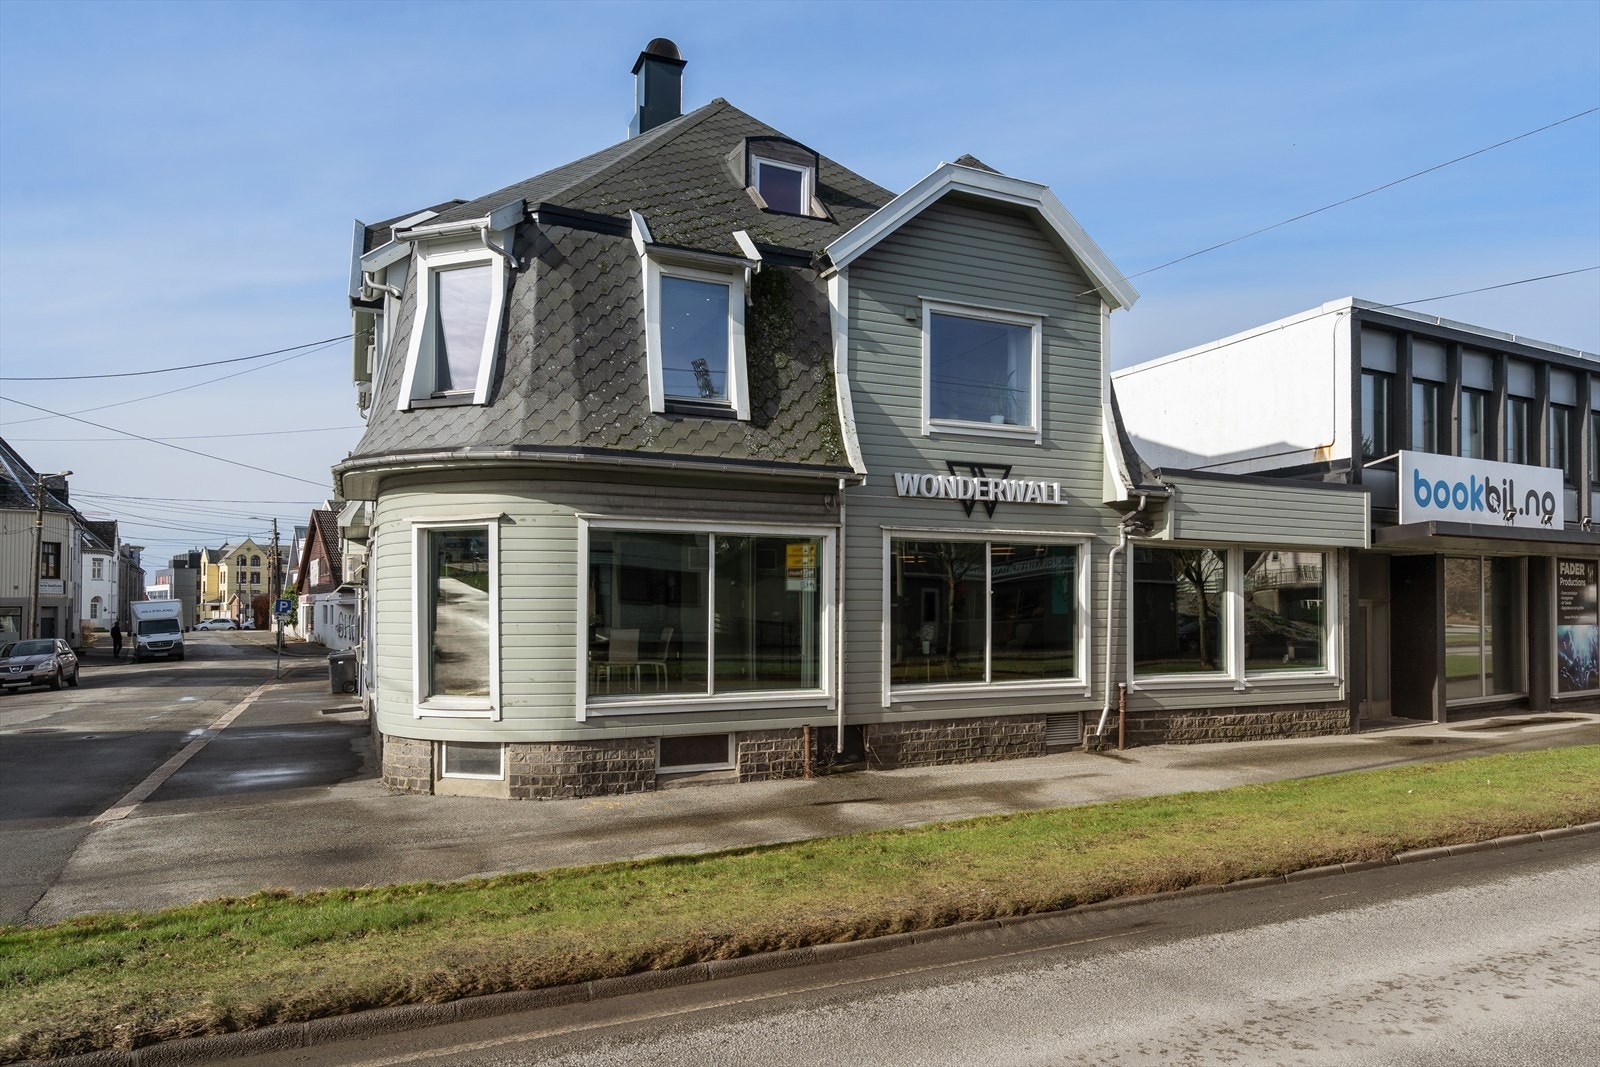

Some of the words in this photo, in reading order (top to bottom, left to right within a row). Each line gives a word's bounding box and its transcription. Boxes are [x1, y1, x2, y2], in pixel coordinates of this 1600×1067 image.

[894, 472, 1068, 505] WONDERWALL
[1413, 468, 1556, 517] bookbil.no
[1560, 562, 1585, 576] FADER
[1560, 577, 1586, 586] Productions
[279, 601, 289, 612] P
